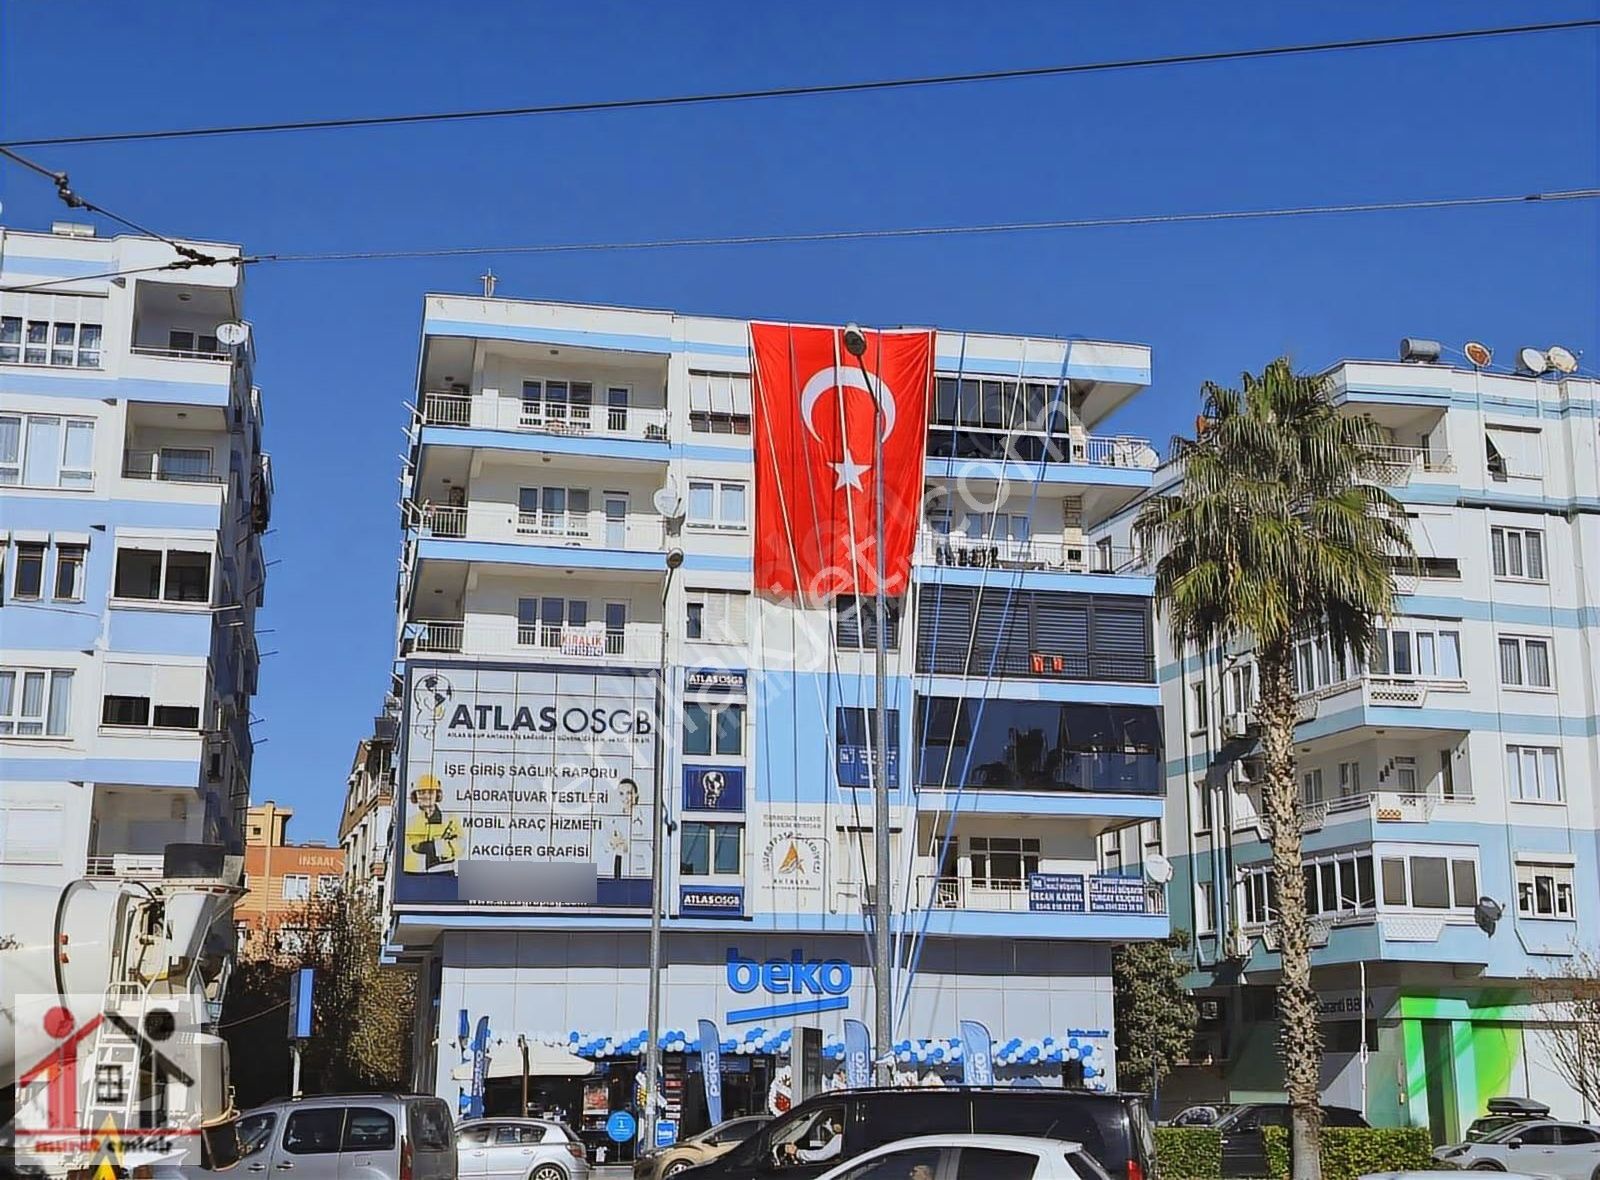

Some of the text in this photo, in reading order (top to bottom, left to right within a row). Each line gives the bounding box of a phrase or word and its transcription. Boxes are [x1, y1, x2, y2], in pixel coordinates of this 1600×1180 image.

[445, 762, 618, 780] İŞE GİRİŞ SAĞLIK RAPORU
[456, 789, 608, 804] LABORATUVAR TESTLERİ
[462, 815, 504, 829] MOBİL
[509, 818, 546, 832] ARAÇ
[537, 844, 589, 857] GRAFİSİ
[726, 947, 852, 995] beko
